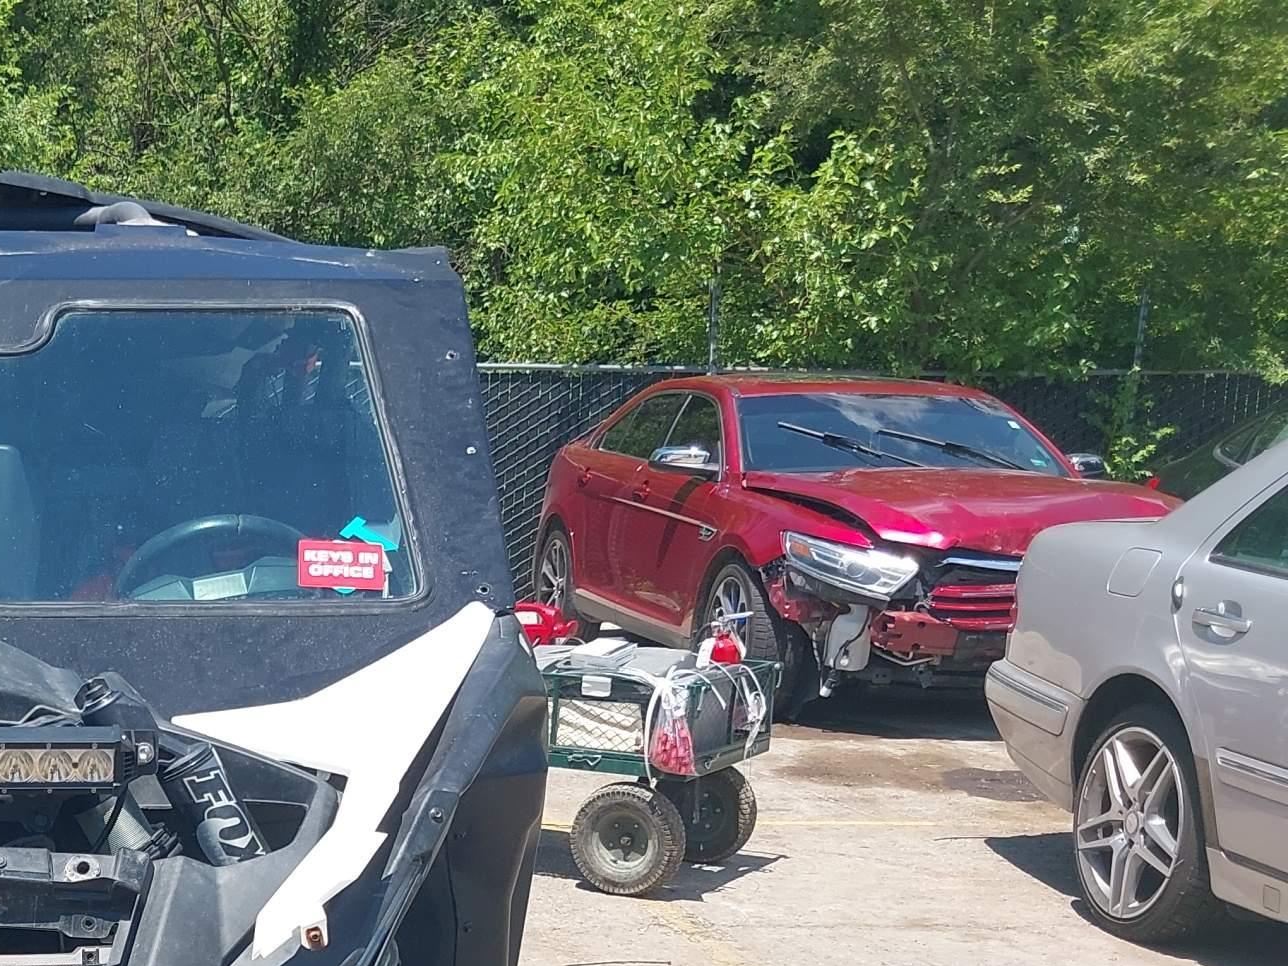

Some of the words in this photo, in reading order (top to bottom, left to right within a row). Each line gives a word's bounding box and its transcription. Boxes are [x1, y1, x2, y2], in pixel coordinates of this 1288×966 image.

[304, 550, 354, 563] KEYS
[358, 552, 379, 564] IN
[308, 564, 374, 579] OFFICE
